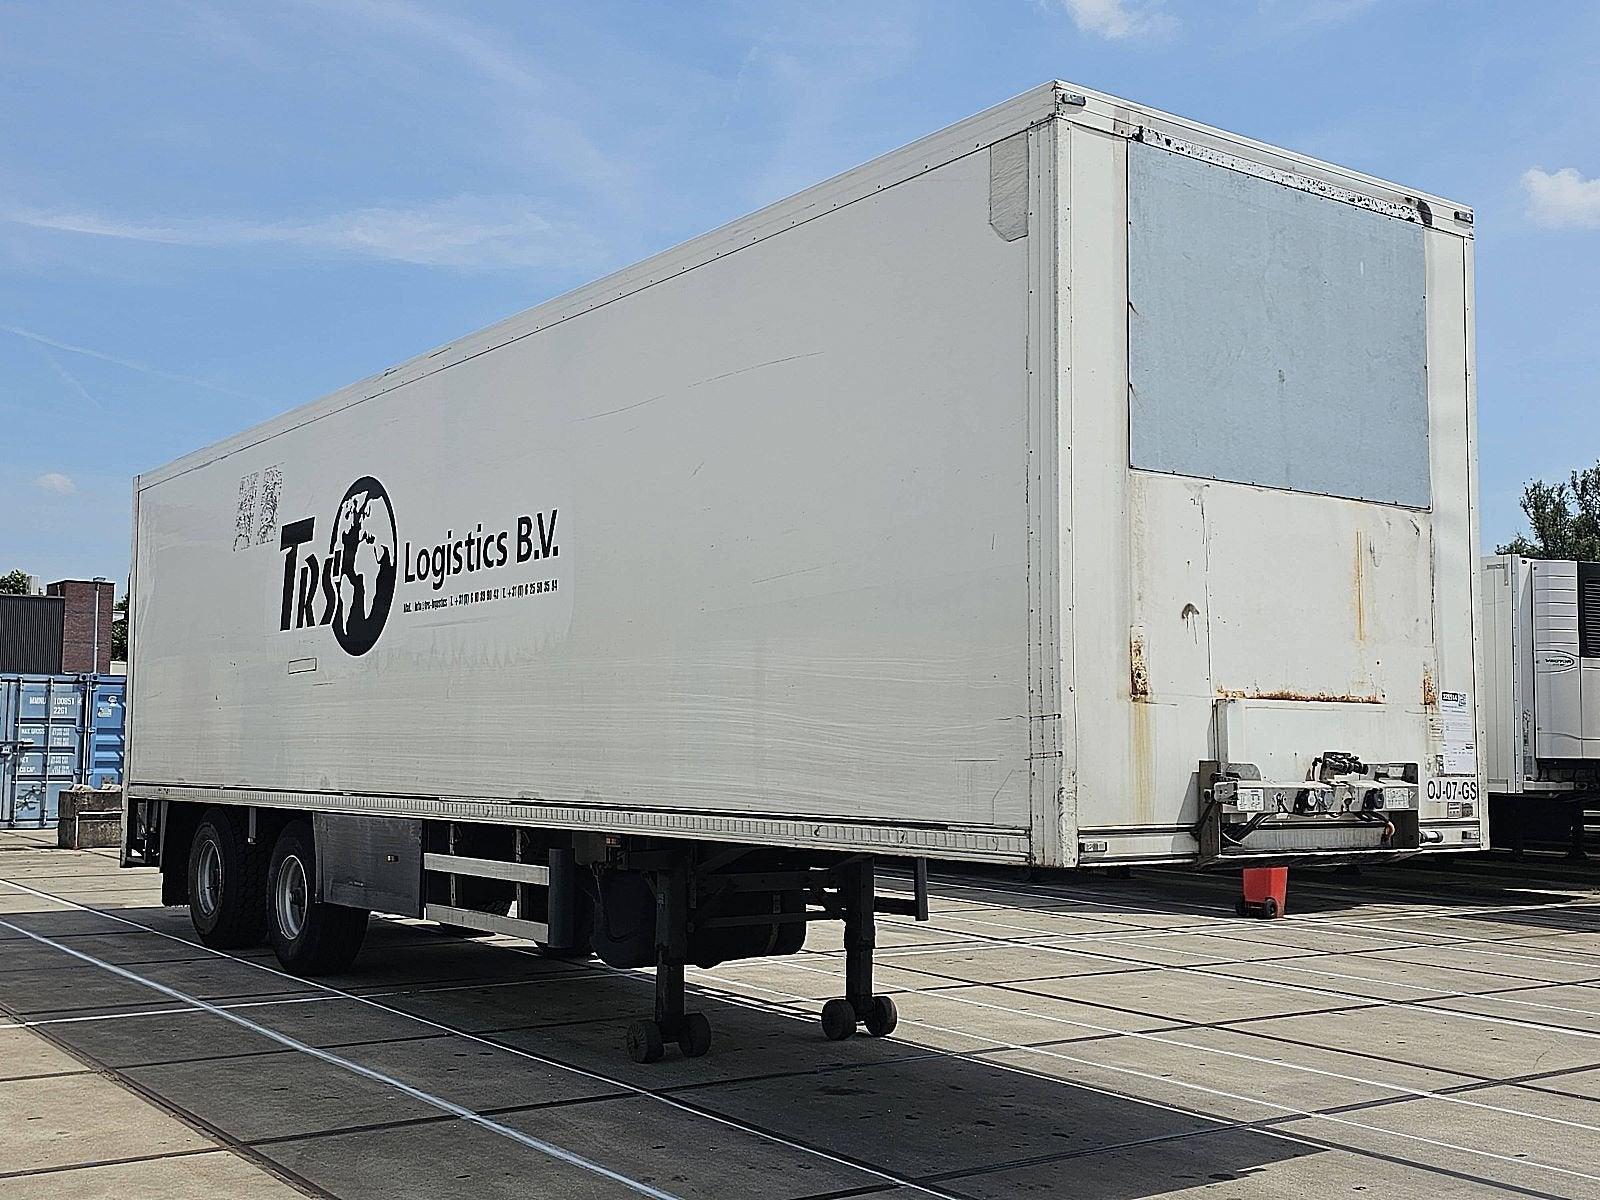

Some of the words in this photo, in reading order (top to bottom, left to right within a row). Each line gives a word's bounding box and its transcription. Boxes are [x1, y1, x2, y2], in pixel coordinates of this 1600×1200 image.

[404, 523, 508, 591] Logistics
[516, 509, 559, 563] B.V.
[1427, 780, 1477, 800] OJ-07-GS
